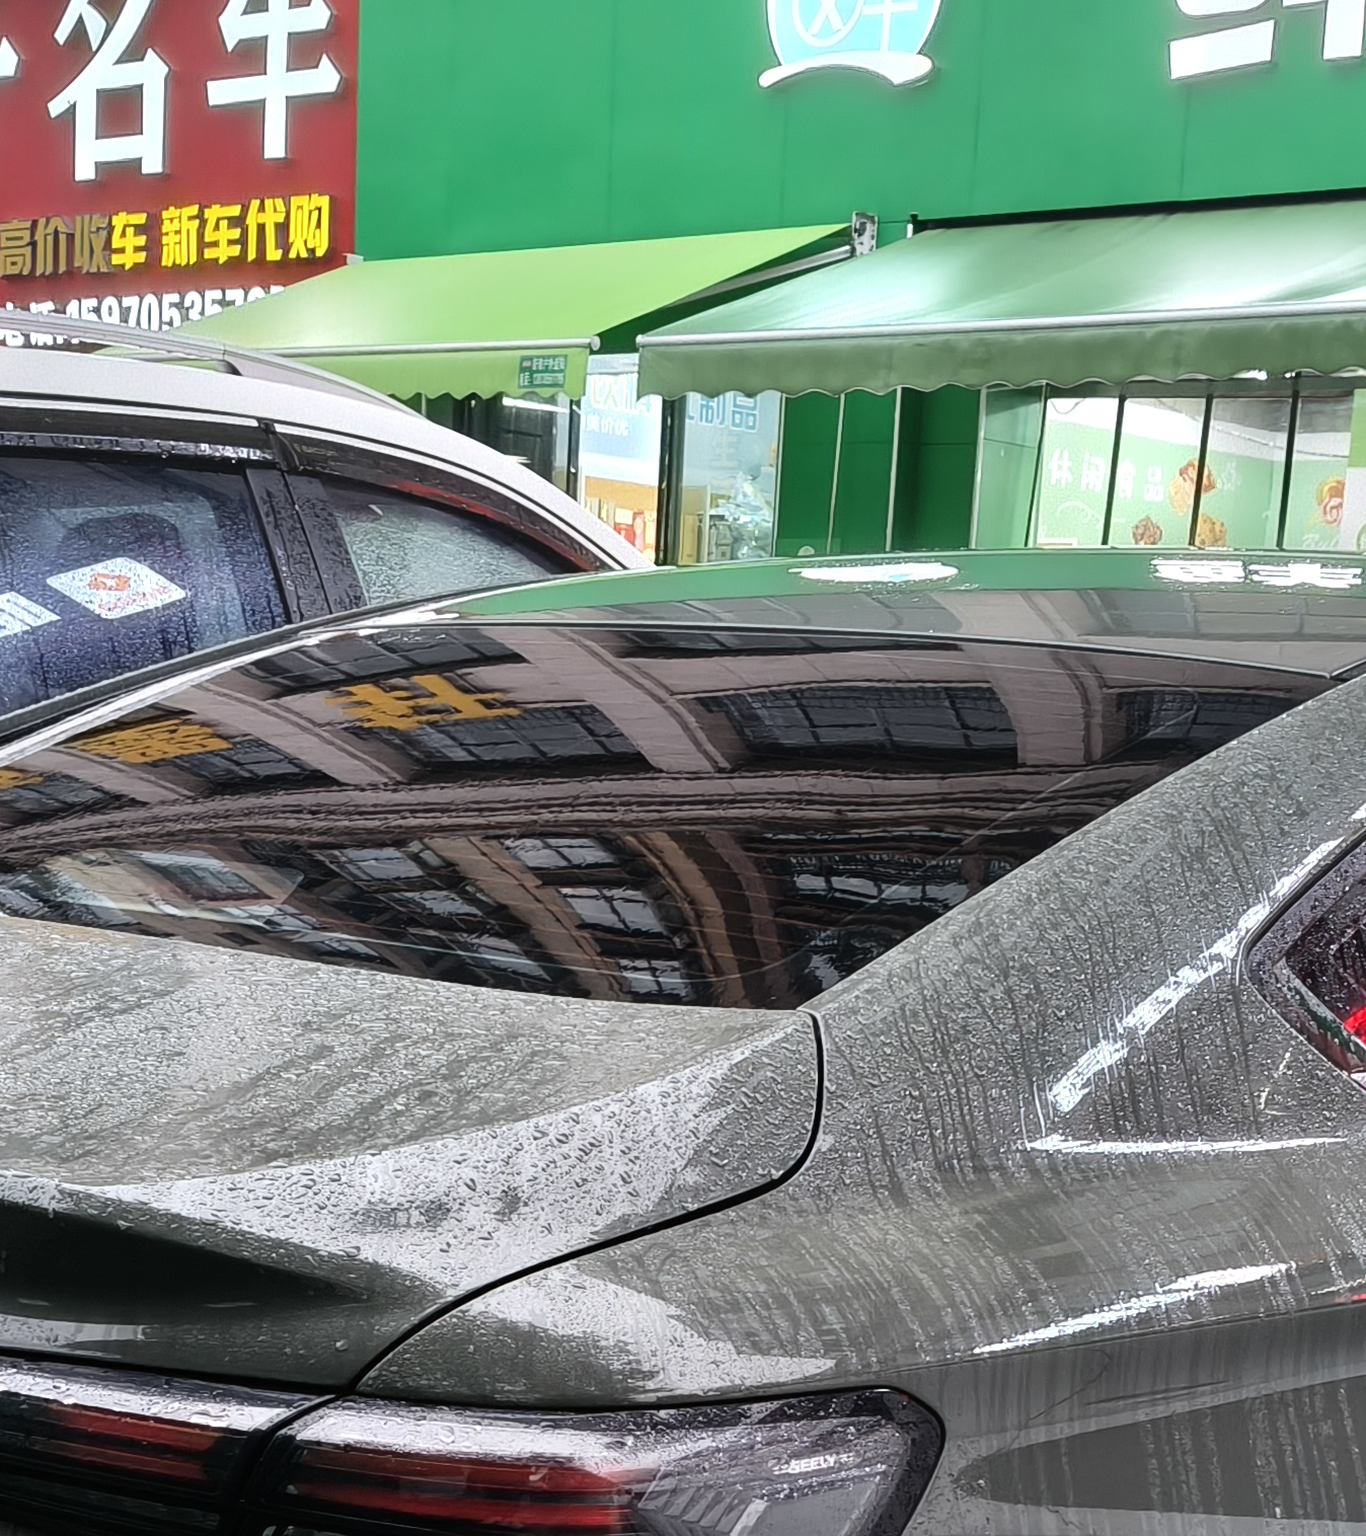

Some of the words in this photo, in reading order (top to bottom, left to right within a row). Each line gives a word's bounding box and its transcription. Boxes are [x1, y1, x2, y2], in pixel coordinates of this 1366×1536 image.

[161, 194, 330, 268] 新车代购
[1048, 450, 1165, 503] 休闲食品
